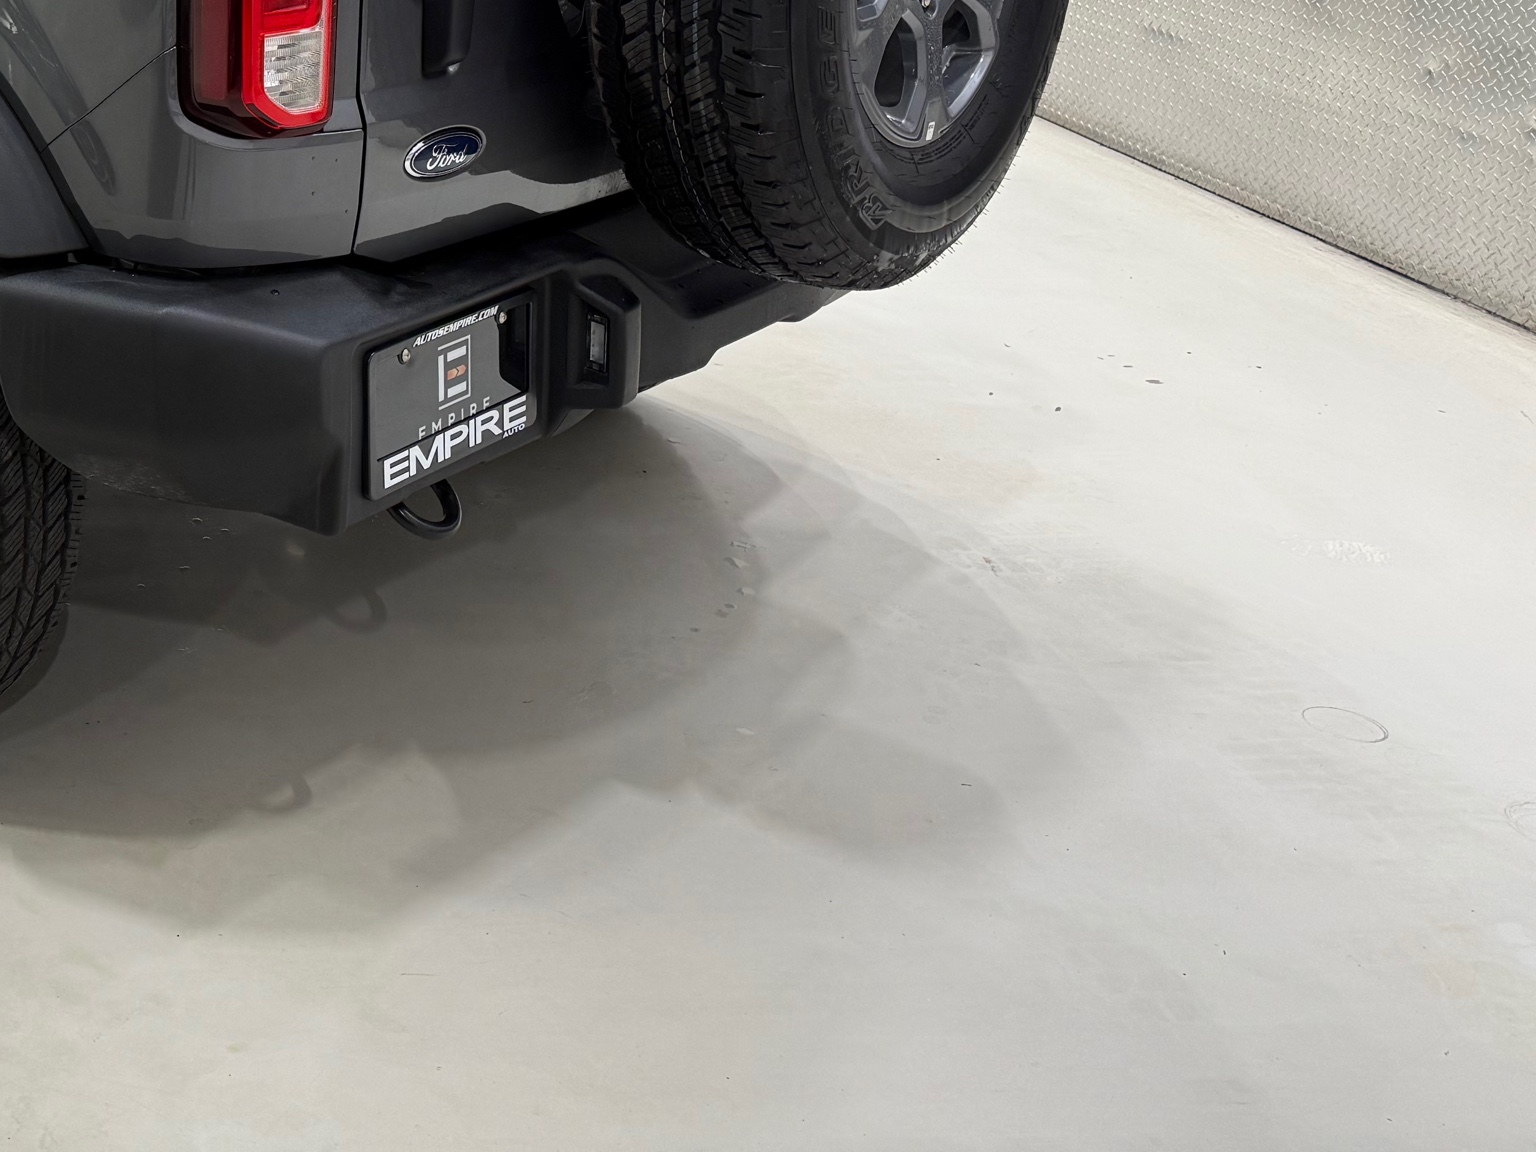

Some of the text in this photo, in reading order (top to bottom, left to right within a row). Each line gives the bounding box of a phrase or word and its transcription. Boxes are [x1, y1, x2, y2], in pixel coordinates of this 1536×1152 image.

[426, 142, 470, 171] Ford
[412, 305, 499, 348] AUTOSEMPIRE.COM
[383, 395, 527, 489] EMPIRE
[502, 423, 526, 439] AUTO
